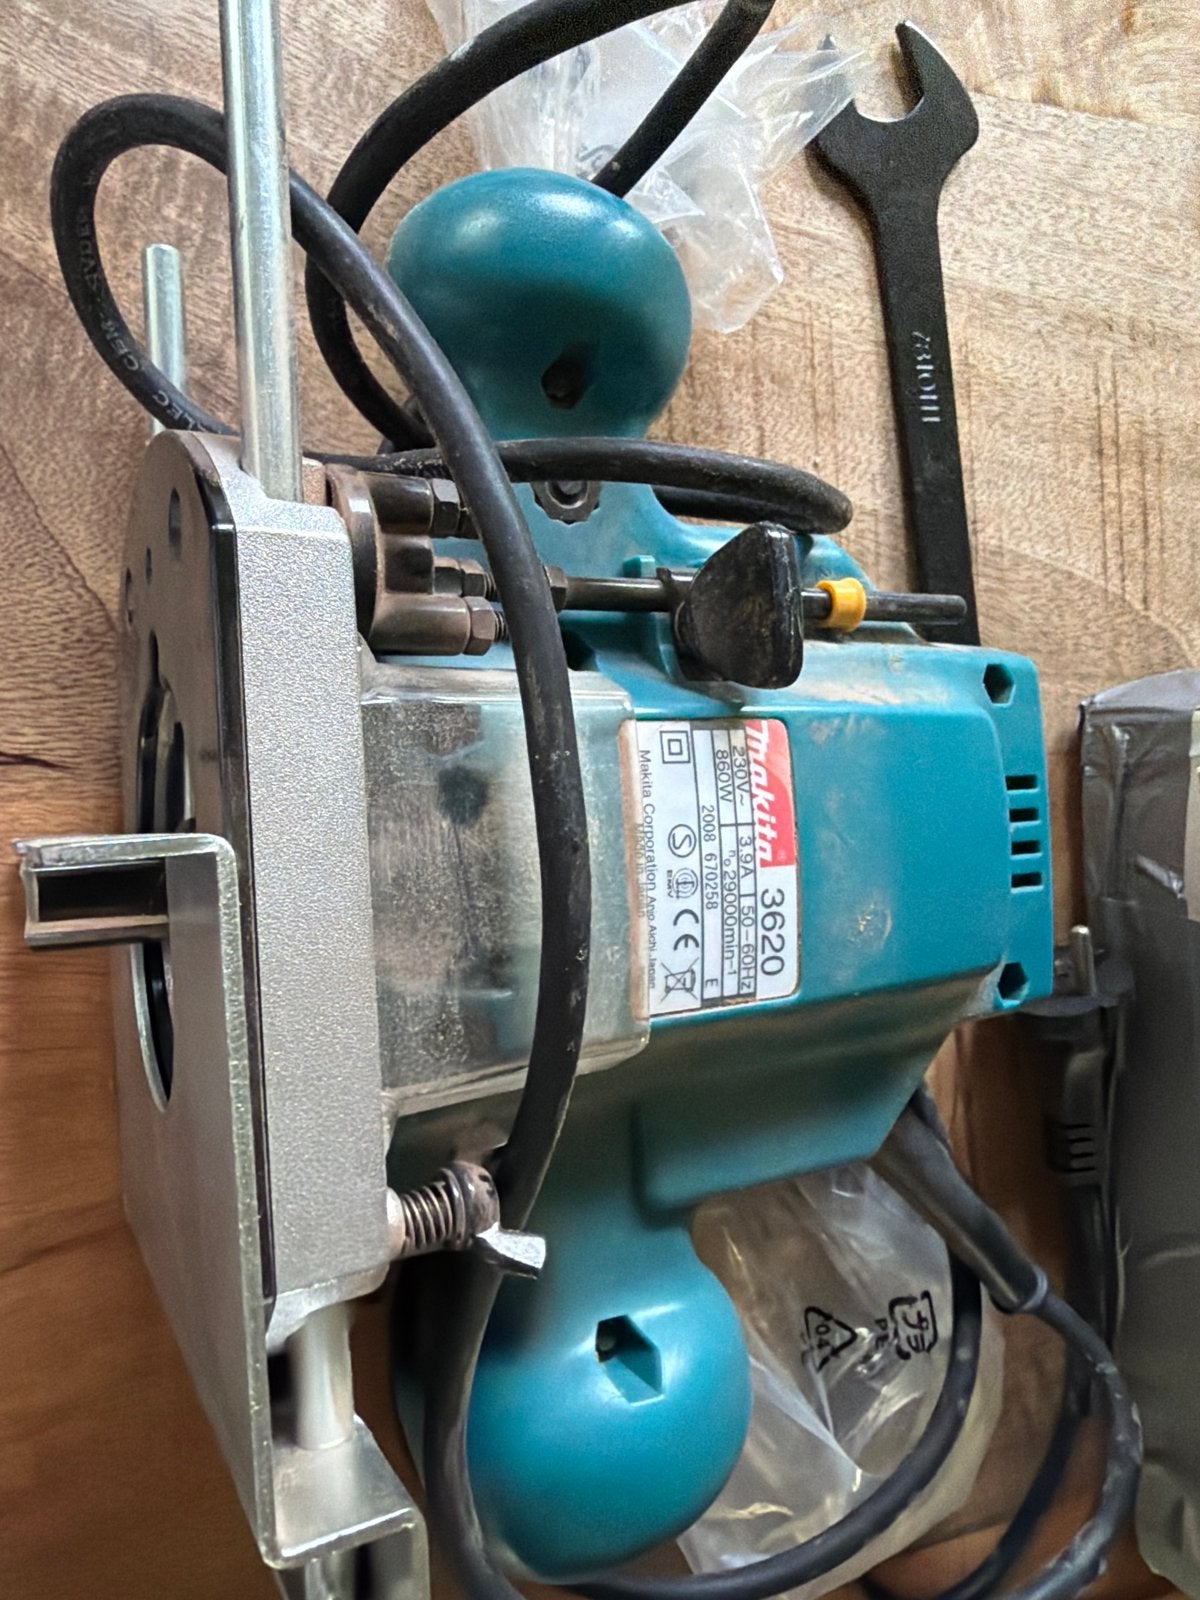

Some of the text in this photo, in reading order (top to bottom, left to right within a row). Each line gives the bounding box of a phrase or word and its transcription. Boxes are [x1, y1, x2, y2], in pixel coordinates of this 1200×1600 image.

[639, 750, 652, 798] Makita
[715, 749, 733, 803] 860W
[643, 803, 658, 891] Corporation
[701, 804, 719, 910] 2008 670258
[739, 836, 754, 878] 3.9A
[648, 925, 658, 951] Aichi
[673, 908, 700, 951] CE
[760, 888, 785, 977] 3620
[704, 978, 719, 989] E
